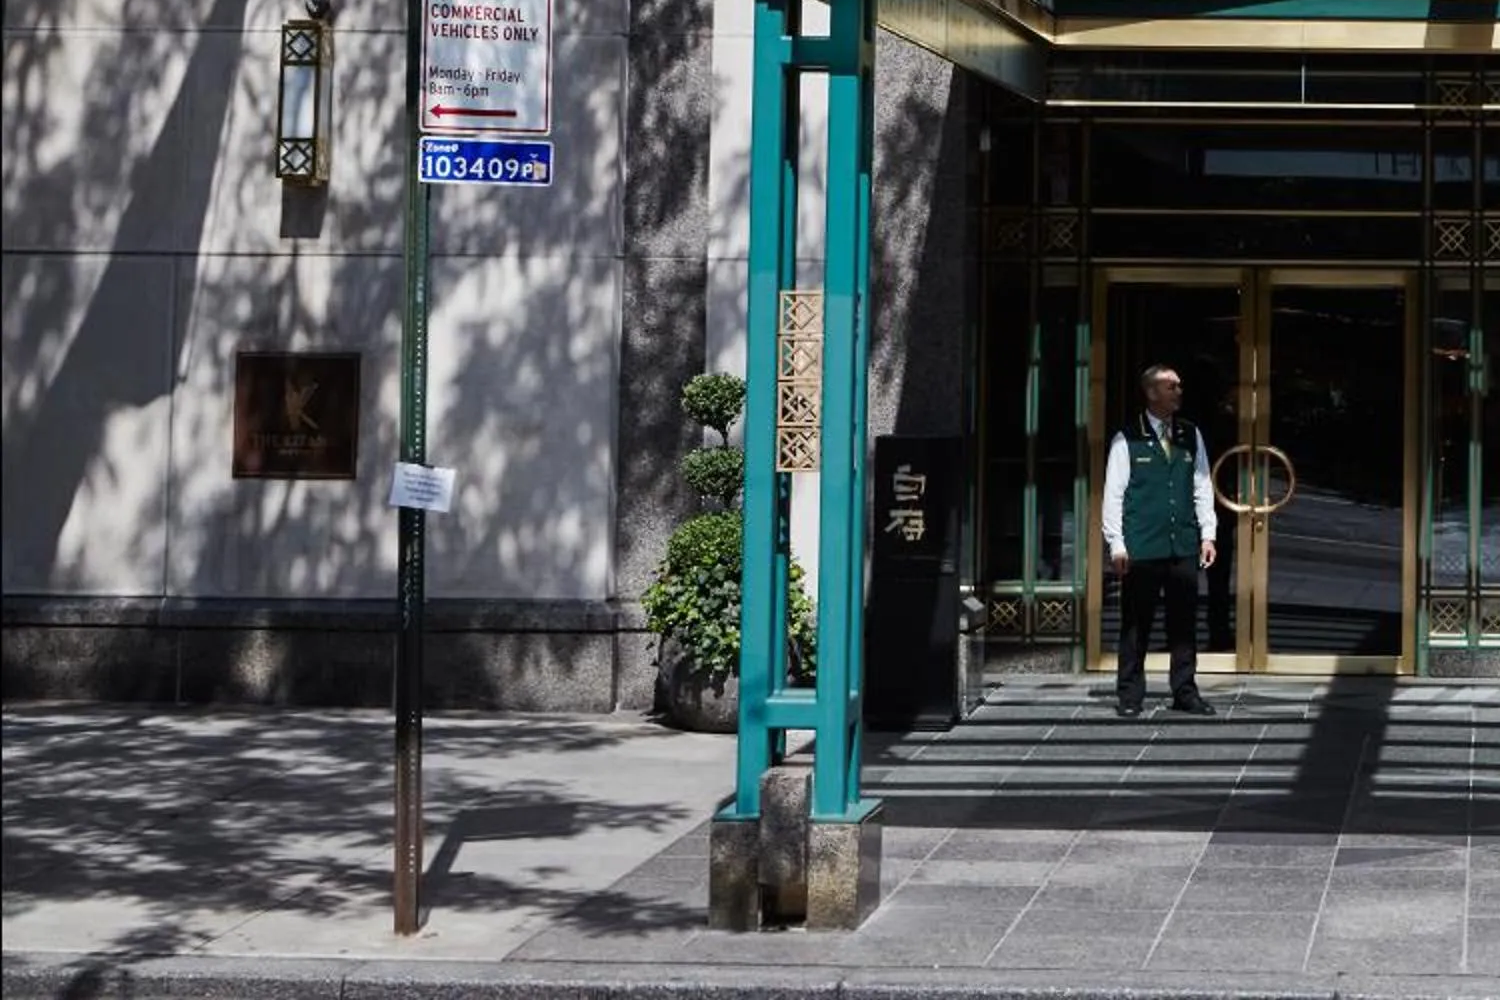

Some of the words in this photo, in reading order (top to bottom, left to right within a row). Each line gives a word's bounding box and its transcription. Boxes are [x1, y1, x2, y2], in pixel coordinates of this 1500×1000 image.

[431, 3, 525, 22] COMMERCIAL
[431, 22, 498, 40] VEHICLES
[503, 25, 539, 42] ONLY
[429, 65, 475, 82] Monday
[485, 66, 521, 83] Friday
[425, 155, 520, 179] 103409
